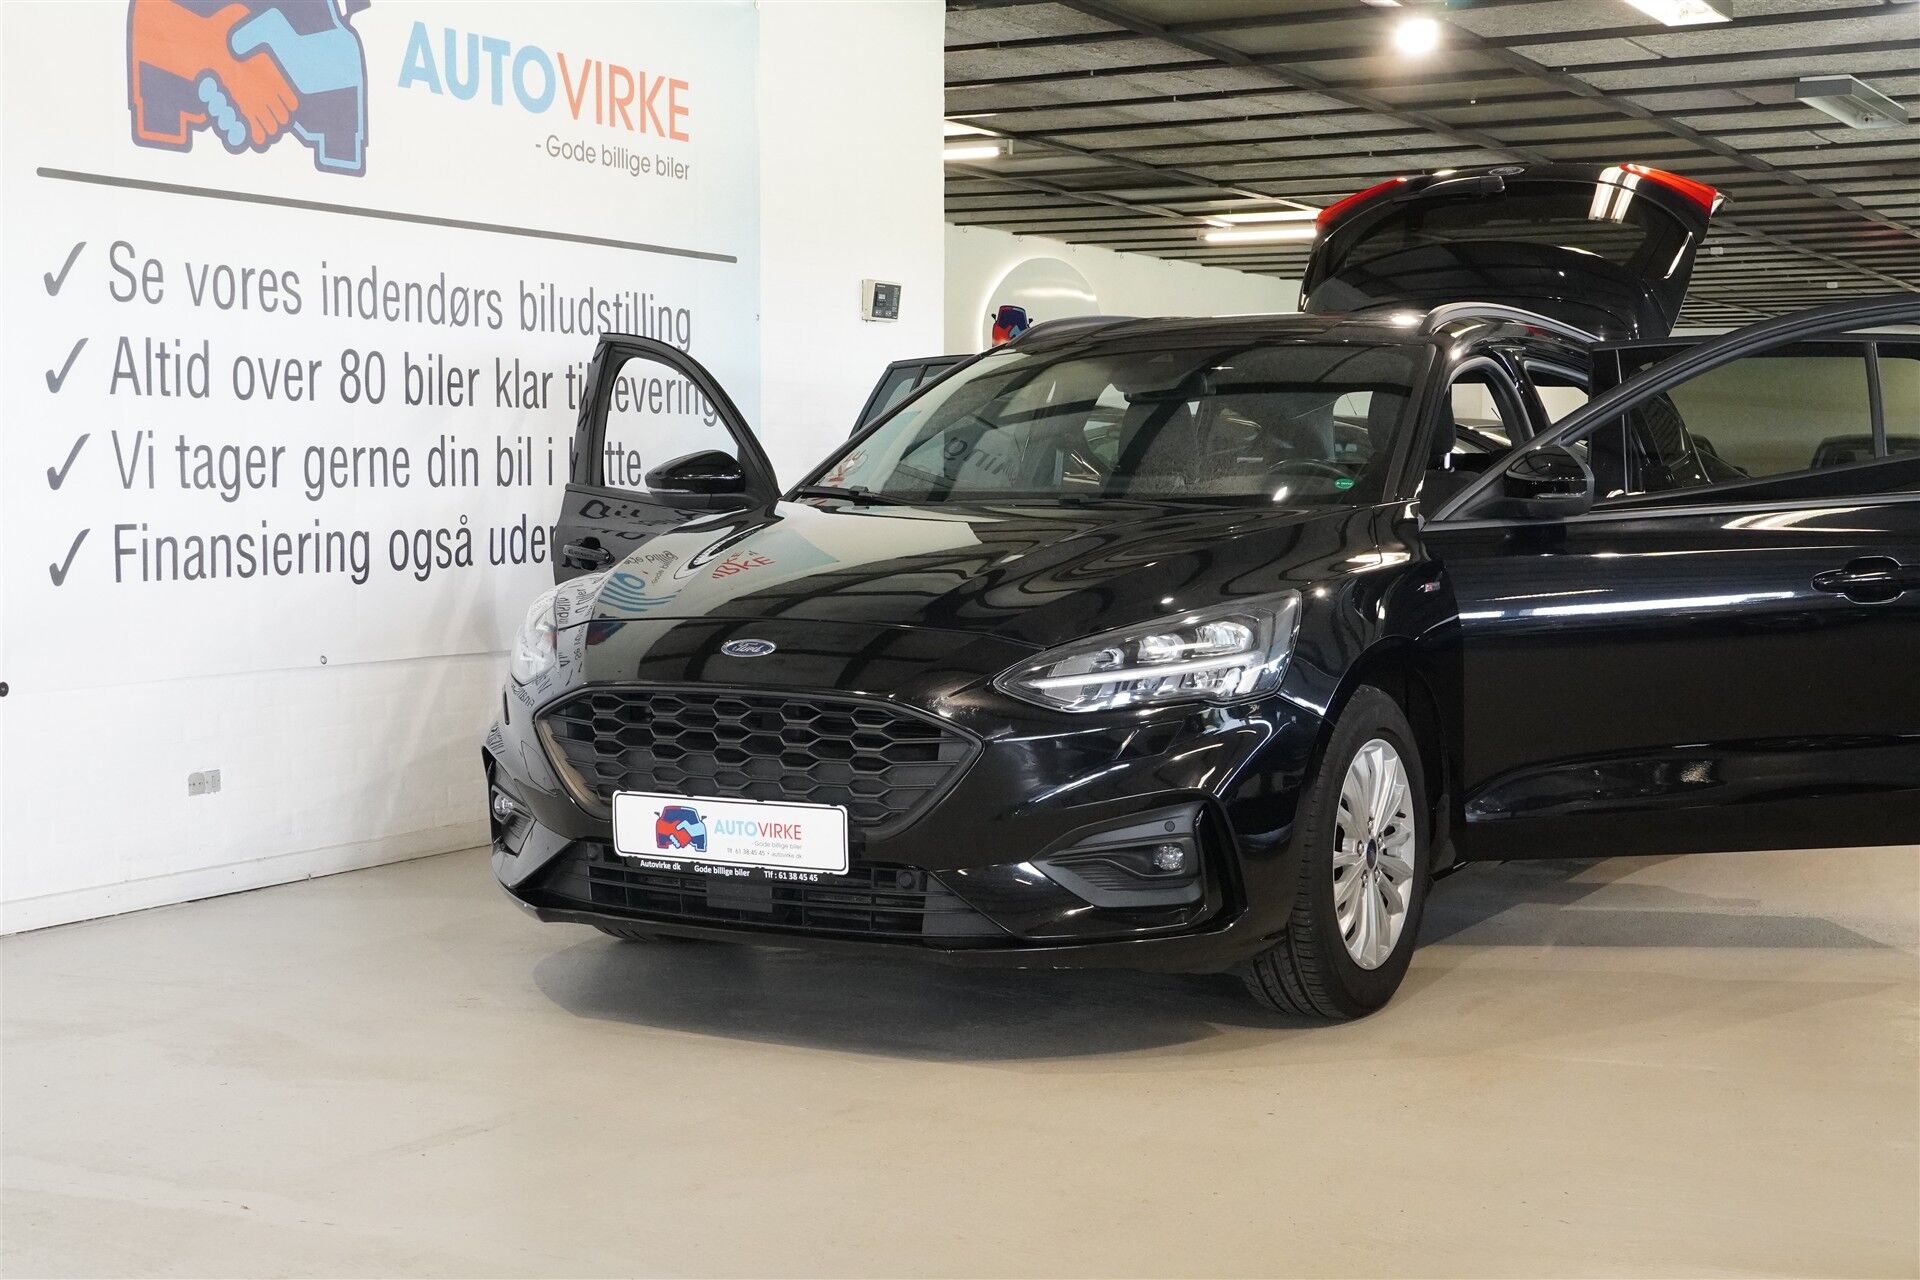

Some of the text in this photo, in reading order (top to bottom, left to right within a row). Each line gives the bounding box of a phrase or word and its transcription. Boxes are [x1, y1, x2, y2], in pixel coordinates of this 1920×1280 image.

[399, 21, 690, 142] AUTOVIRKE
[546, 134, 596, 163] Gode
[601, 144, 651, 177] billige
[655, 154, 690, 180] biler
[109, 240, 692, 352] Se vores indendørs biludstilling
[110, 335, 210, 399] Altid
[232, 355, 323, 404] over
[339, 348, 386, 406] 80
[404, 350, 481, 410] biler
[495, 355, 554, 410] klar
[110, 429, 154, 491] Vi
[174, 434, 286, 503] tager
[303, 445, 411, 503] gerne
[427, 434, 479, 489] din
[496, 434, 533, 488] bil
[547, 434, 555, 486] i
[114, 519, 370, 587] Finansiering
[388, 514, 474, 584] også
[714, 819, 802, 841] AUTOVIRKE
[694, 864, 750, 877] Gode billige biler
[778, 871, 787, 880] 61
[788, 872, 798, 881] 38
[798, 873, 808, 881] 45
[808, 873, 818, 882] 45
